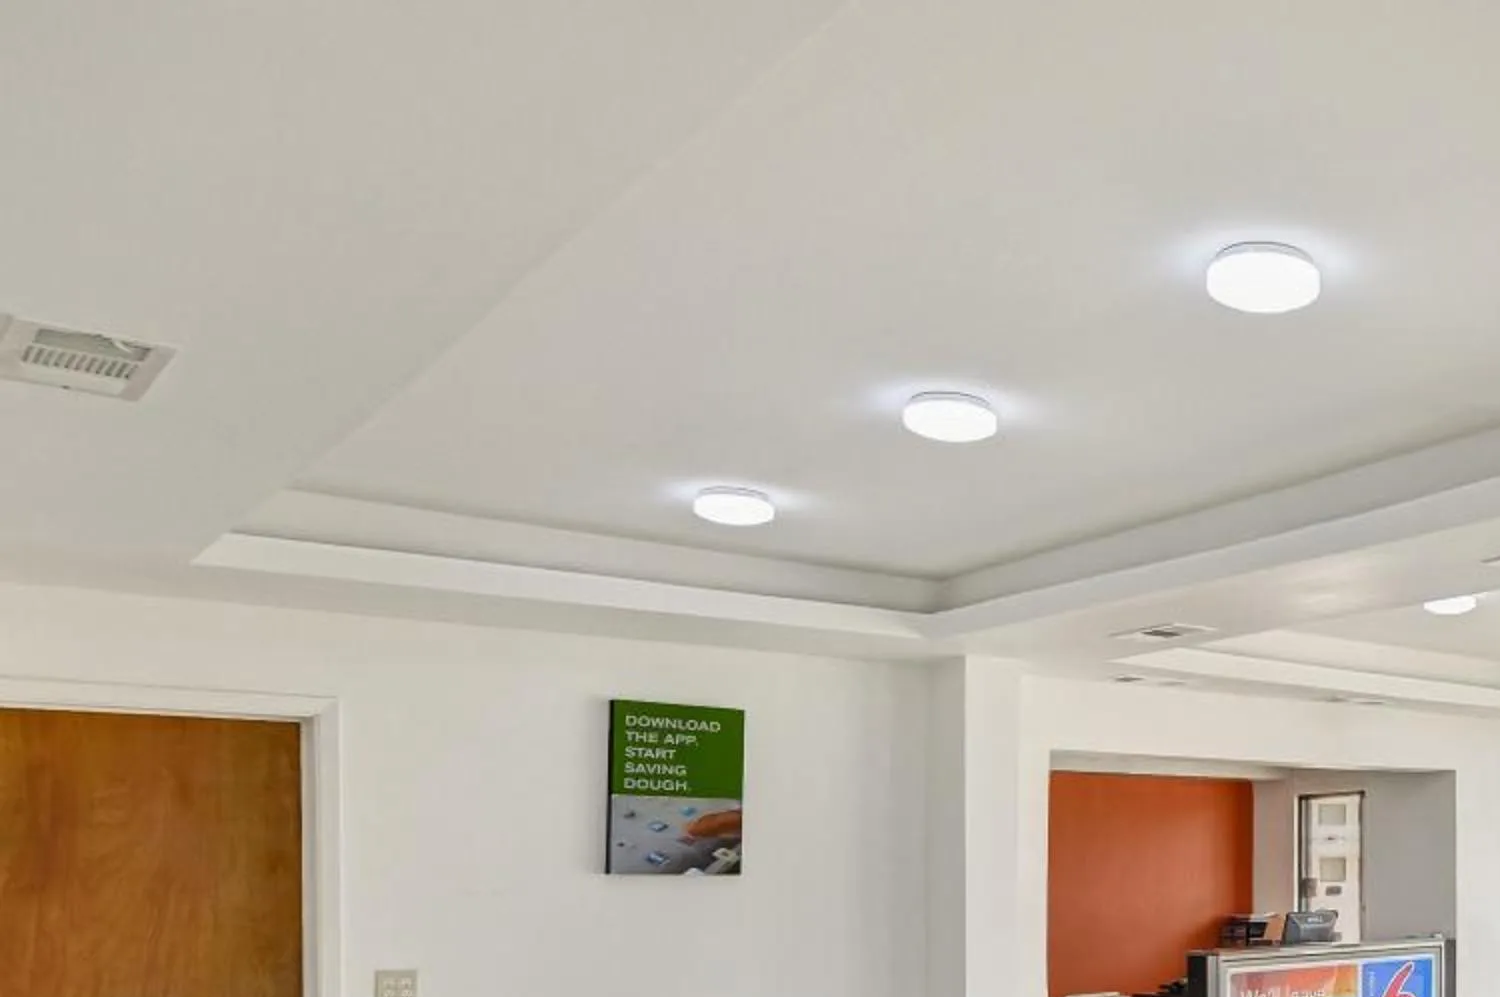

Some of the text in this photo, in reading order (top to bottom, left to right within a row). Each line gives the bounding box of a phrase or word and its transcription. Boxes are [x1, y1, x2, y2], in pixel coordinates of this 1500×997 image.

[625, 715, 721, 732] DOWNLOAD
[625, 731, 658, 744] THE
[624, 747, 677, 760] START
[624, 762, 687, 776] SAVING
[623, 778, 692, 792] DOUGH.
